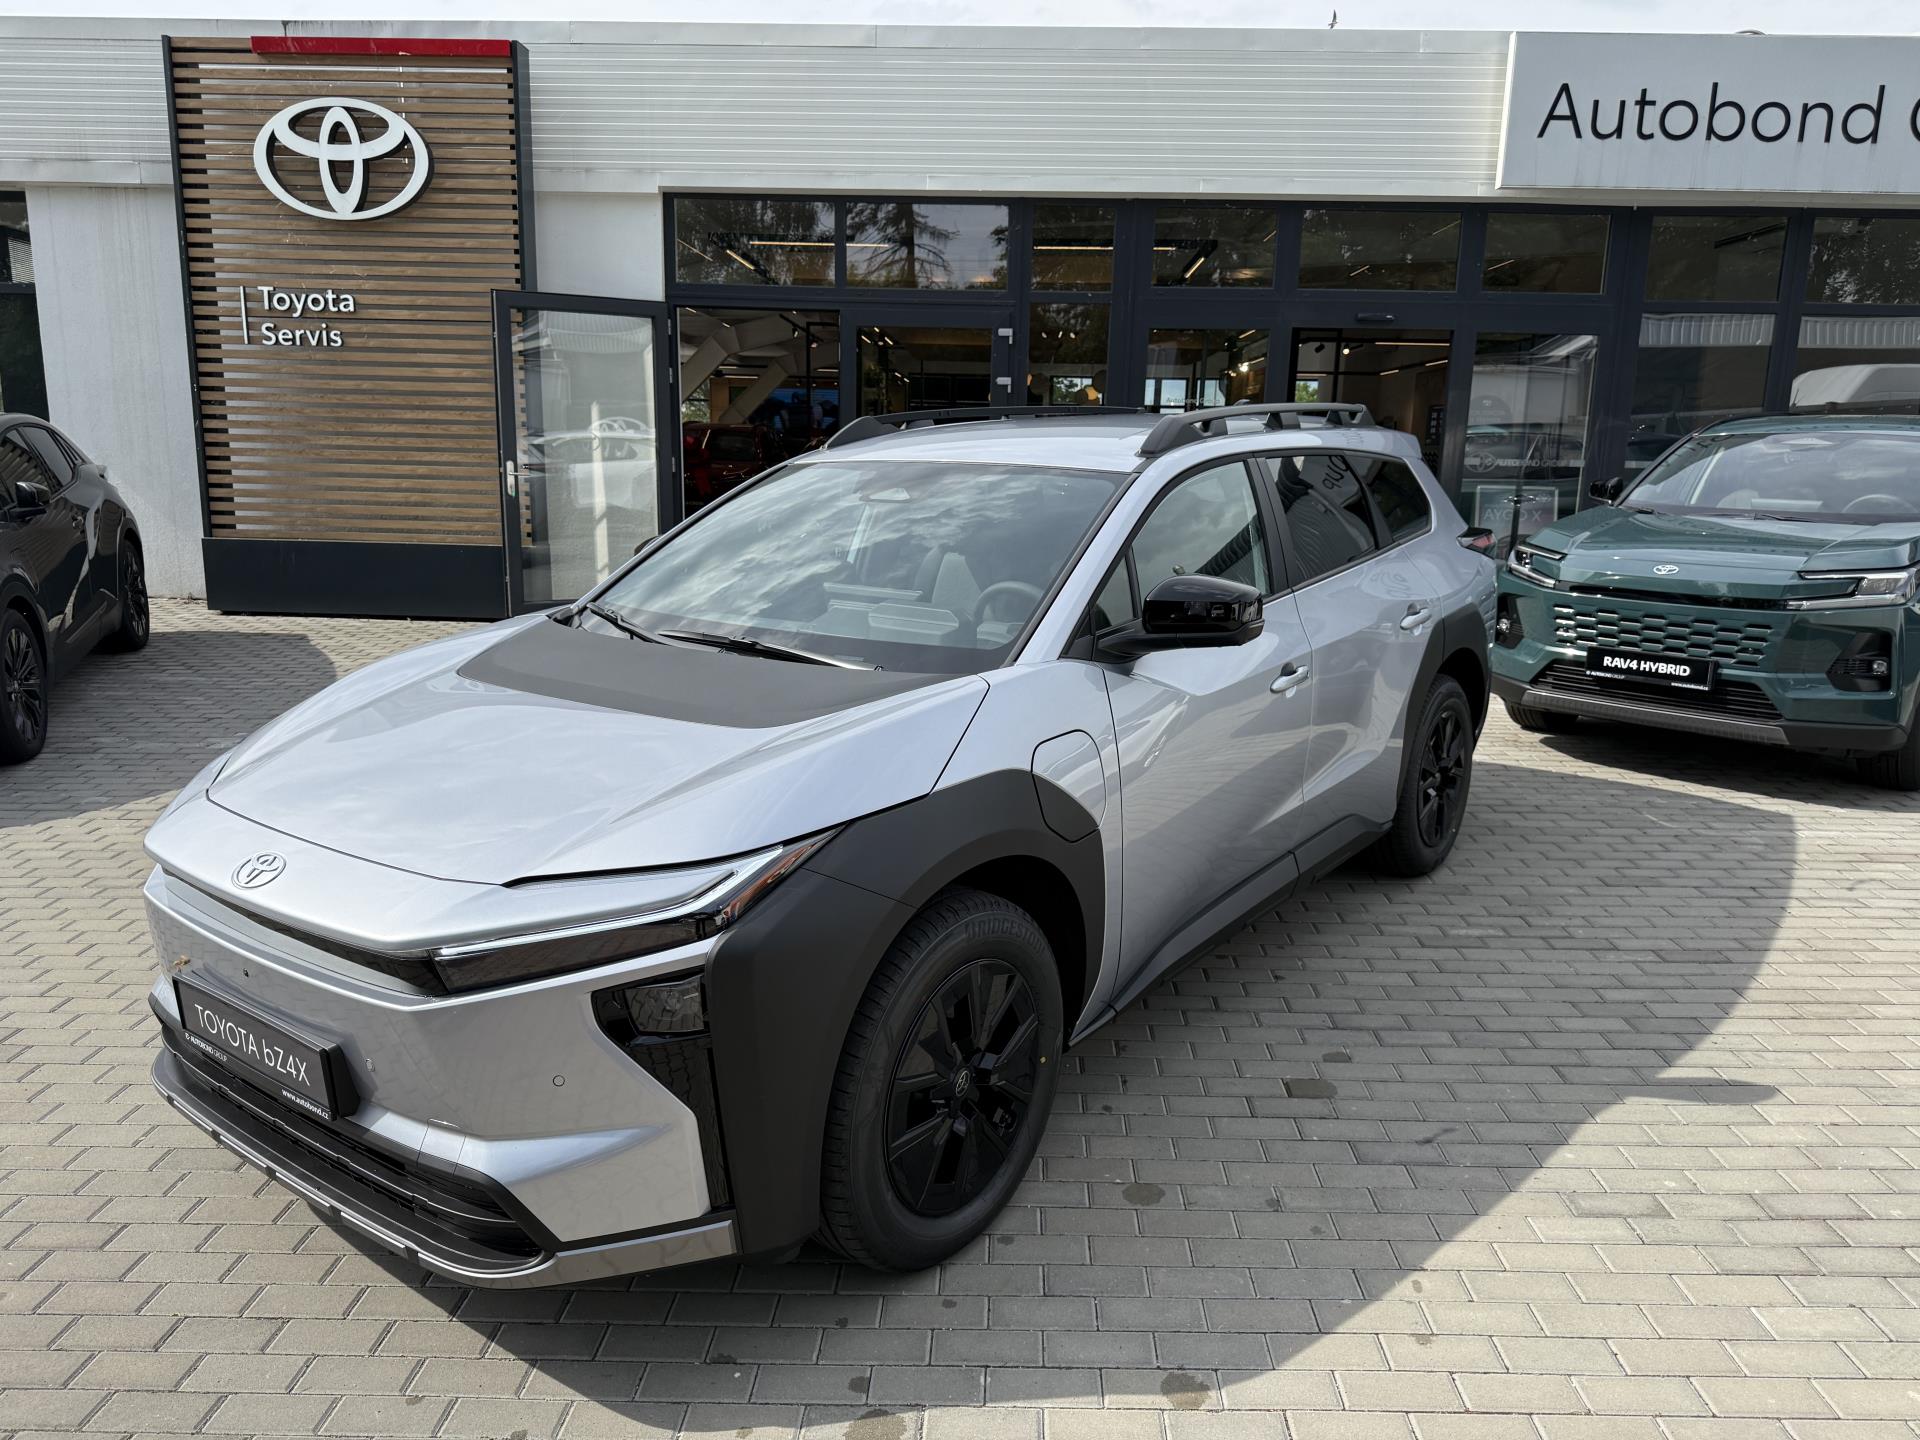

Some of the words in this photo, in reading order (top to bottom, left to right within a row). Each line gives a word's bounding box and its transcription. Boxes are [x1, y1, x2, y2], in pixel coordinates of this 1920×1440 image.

[1537, 82, 1886, 145] Autobond
[257, 286, 355, 318] Toyota
[261, 322, 343, 347] Servis
[1483, 507, 1528, 521] AYGO
[1531, 510, 1544, 521] X
[1603, 656, 1638, 670] RAV4
[1640, 661, 1690, 677] HYBRID
[190, 1035, 213, 1054] AUTOBOND
[195, 1004, 260, 1060] TOYOTA
[262, 1039, 310, 1086] bZ4X
[281, 1089, 329, 1120] www.autobond.cz
